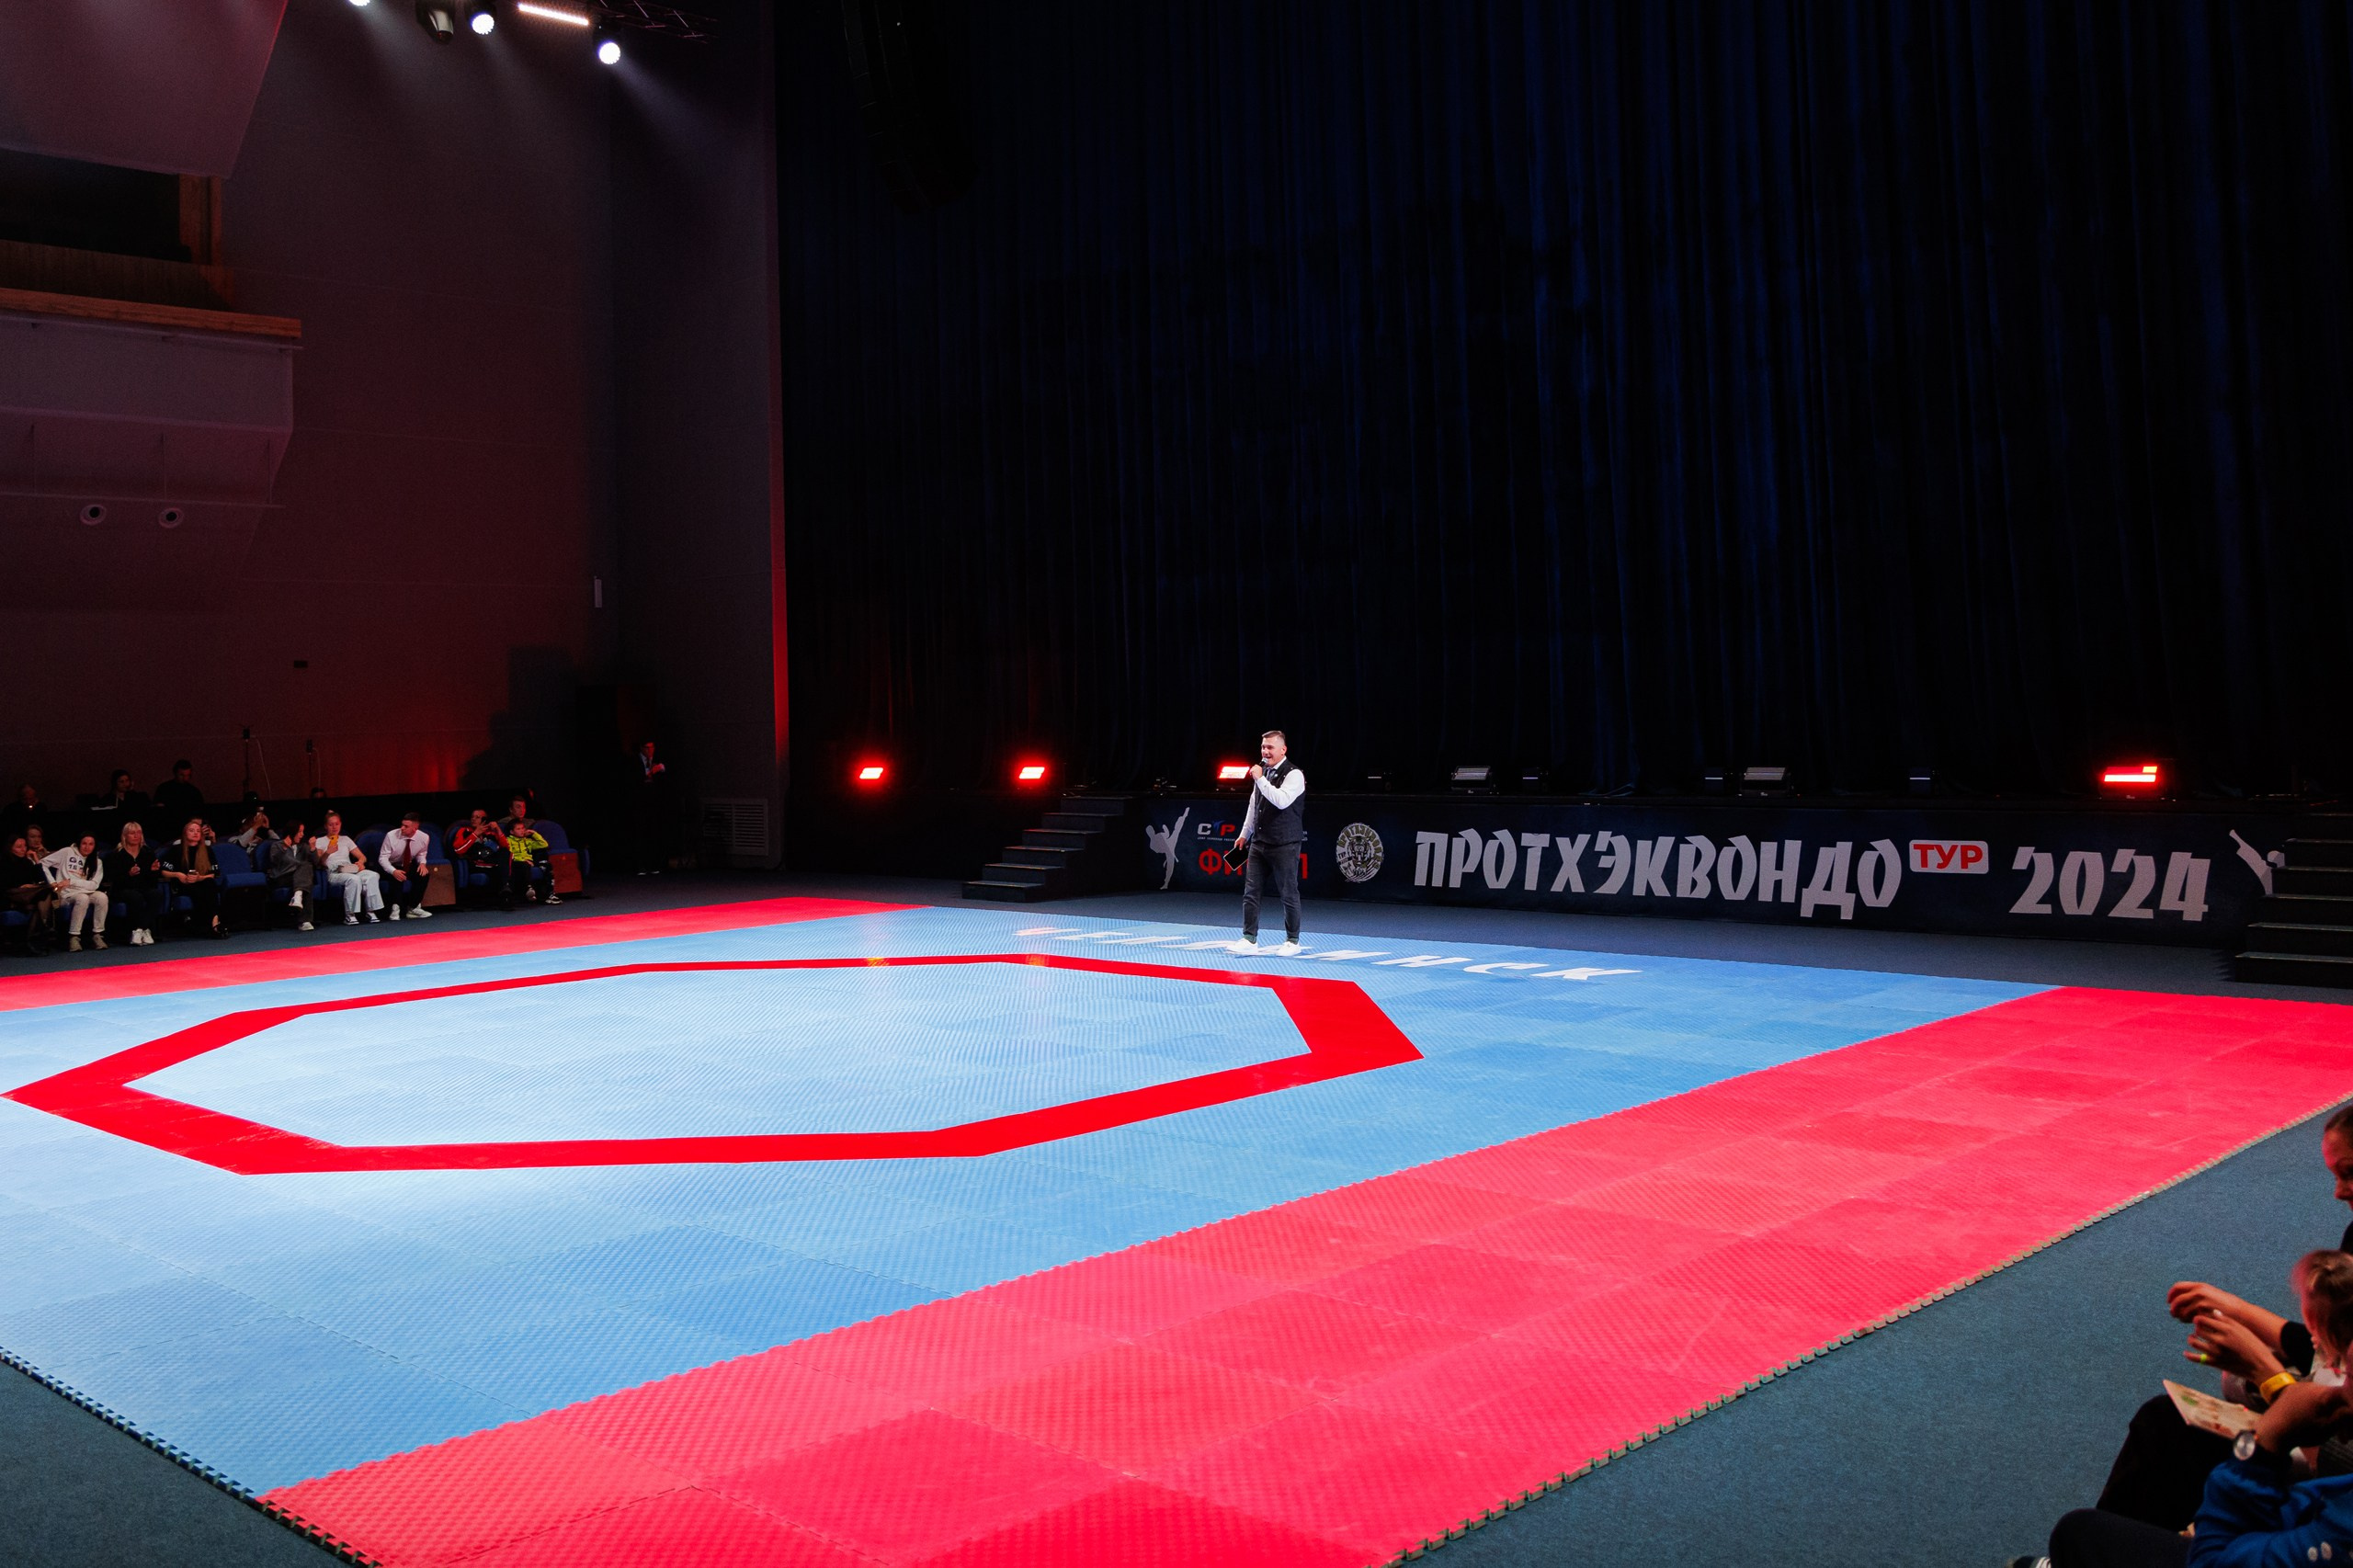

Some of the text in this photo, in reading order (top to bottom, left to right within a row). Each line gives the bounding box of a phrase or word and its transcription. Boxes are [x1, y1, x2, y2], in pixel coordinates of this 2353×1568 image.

[1414, 828, 2211, 922] ПРОТХЭКВОНДО ТУР 2024
